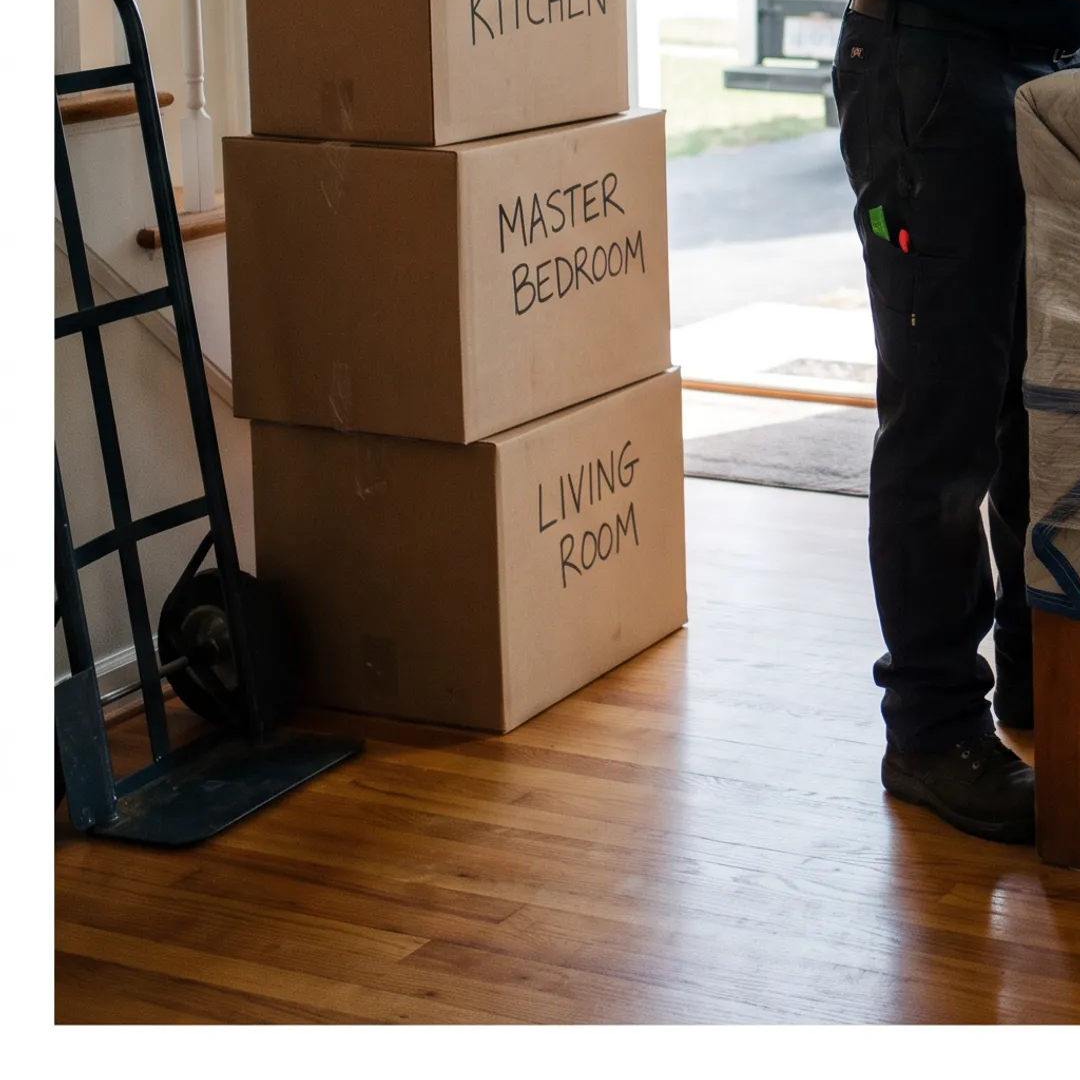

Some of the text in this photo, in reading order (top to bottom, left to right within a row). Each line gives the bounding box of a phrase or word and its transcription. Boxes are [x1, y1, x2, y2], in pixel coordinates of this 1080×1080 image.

[498, 172, 625, 254] MASTER
[511, 230, 646, 316] BEDROOM
[538, 440, 640, 533] LIVING
[559, 501, 639, 589] ROOM
